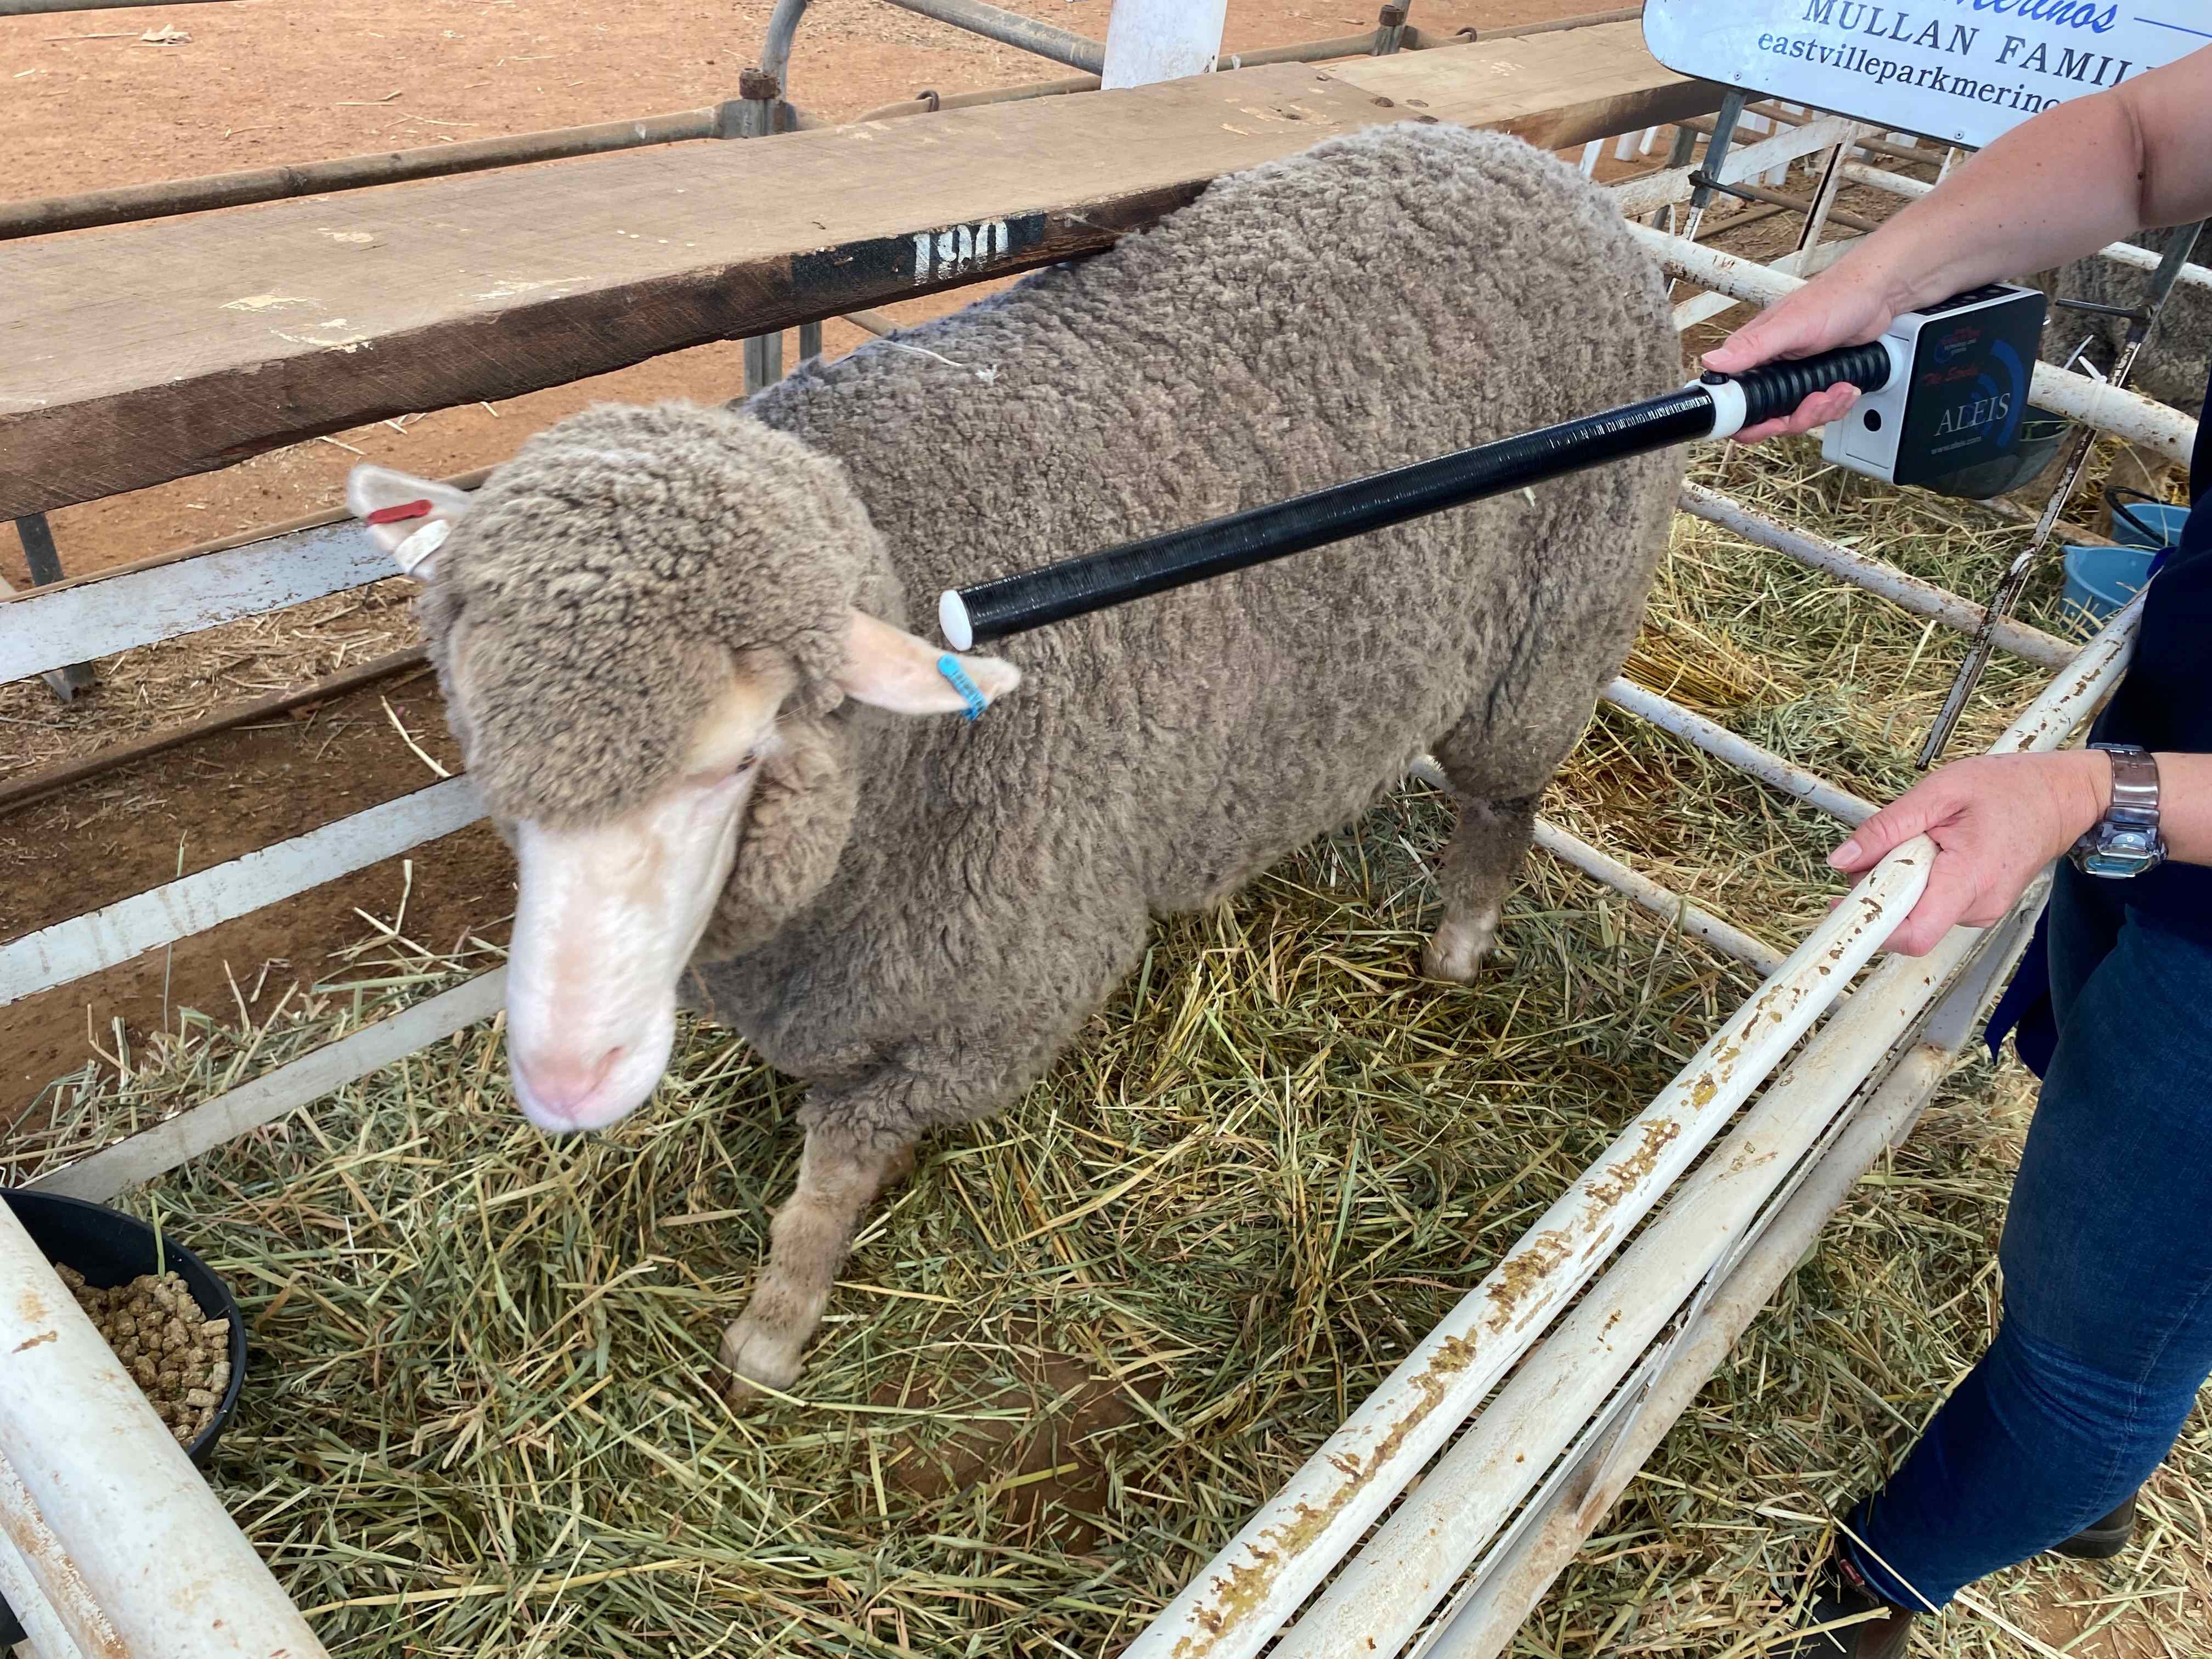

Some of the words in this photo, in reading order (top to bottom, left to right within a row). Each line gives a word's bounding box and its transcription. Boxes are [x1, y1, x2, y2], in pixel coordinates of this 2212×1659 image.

[1956, 0, 2118, 33] erinos
[1802, 0, 1980, 55] MULLAN
[1995, 35, 2156, 88] FAMIL
[1933, 393, 2011, 437] ALEIS
